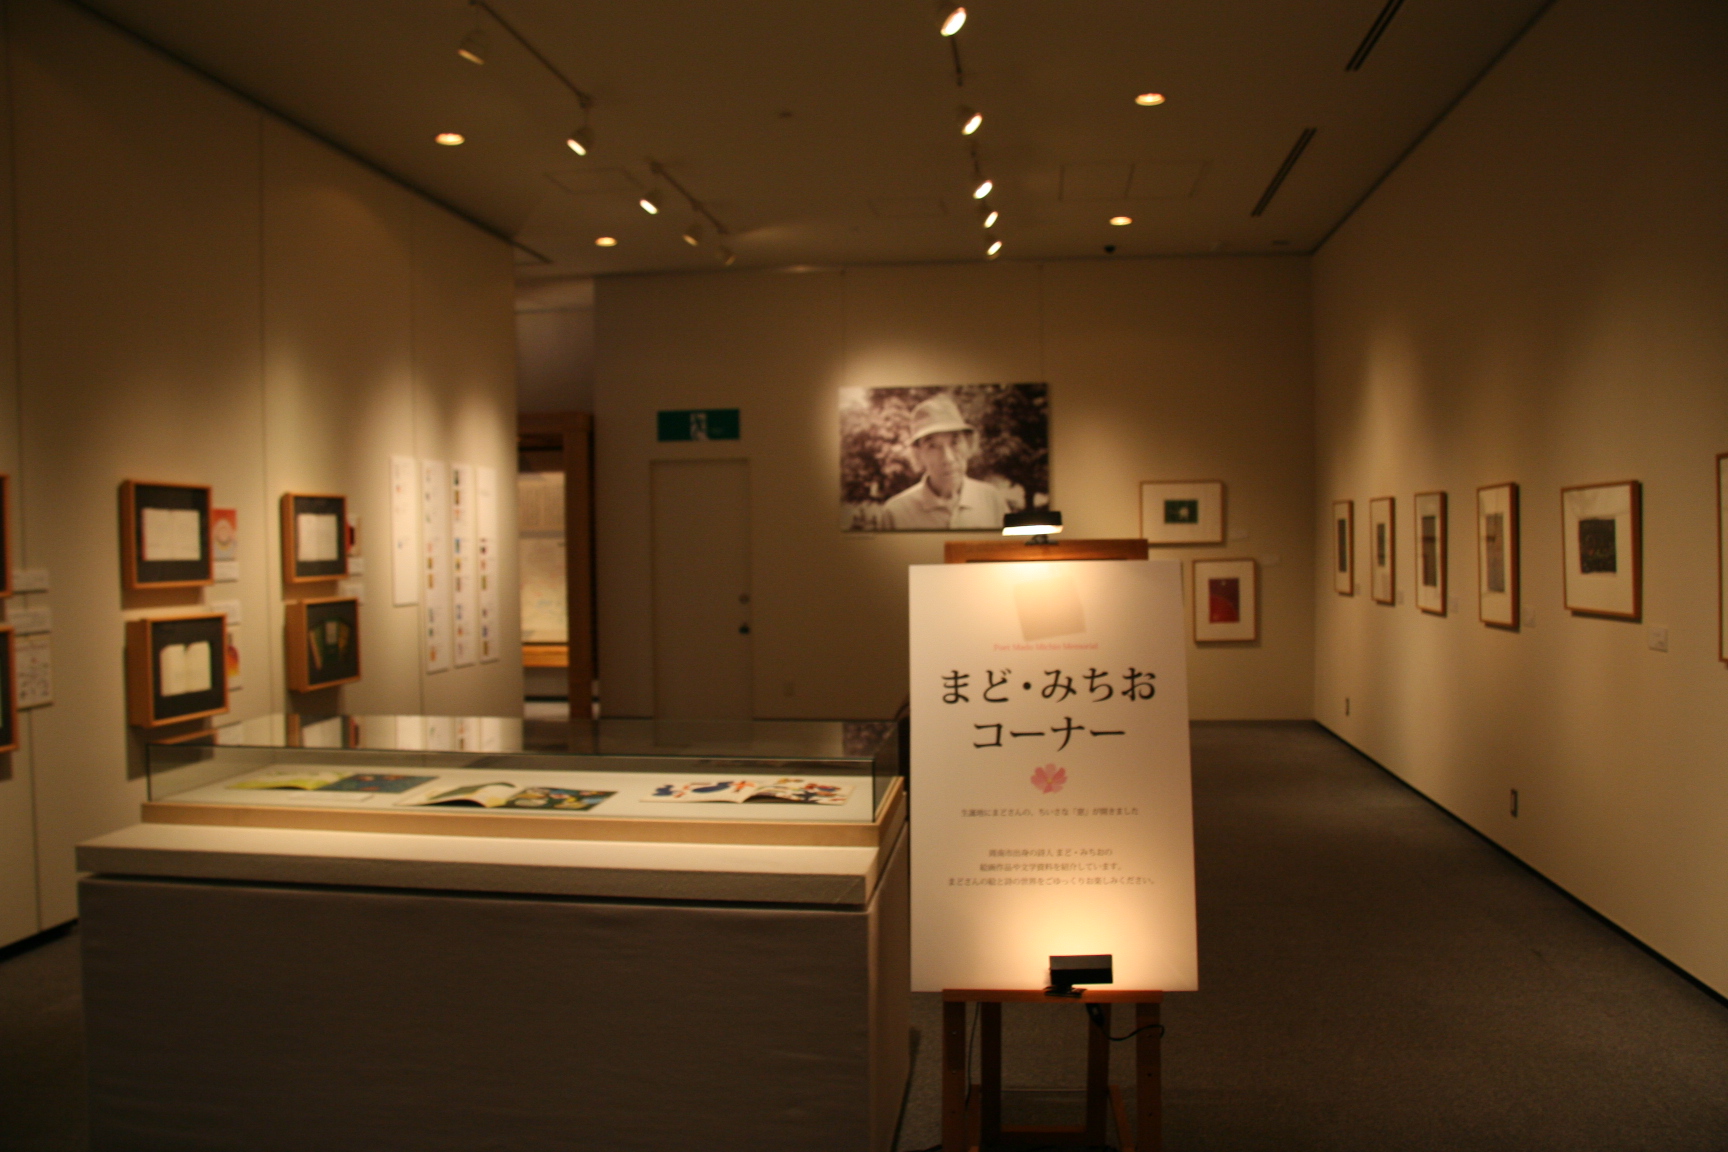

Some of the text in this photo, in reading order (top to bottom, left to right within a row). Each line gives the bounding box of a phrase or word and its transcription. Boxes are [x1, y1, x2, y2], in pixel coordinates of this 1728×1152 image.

[941, 667, 1156, 704] まど・みちお
[973, 716, 1126, 752] コーナー
